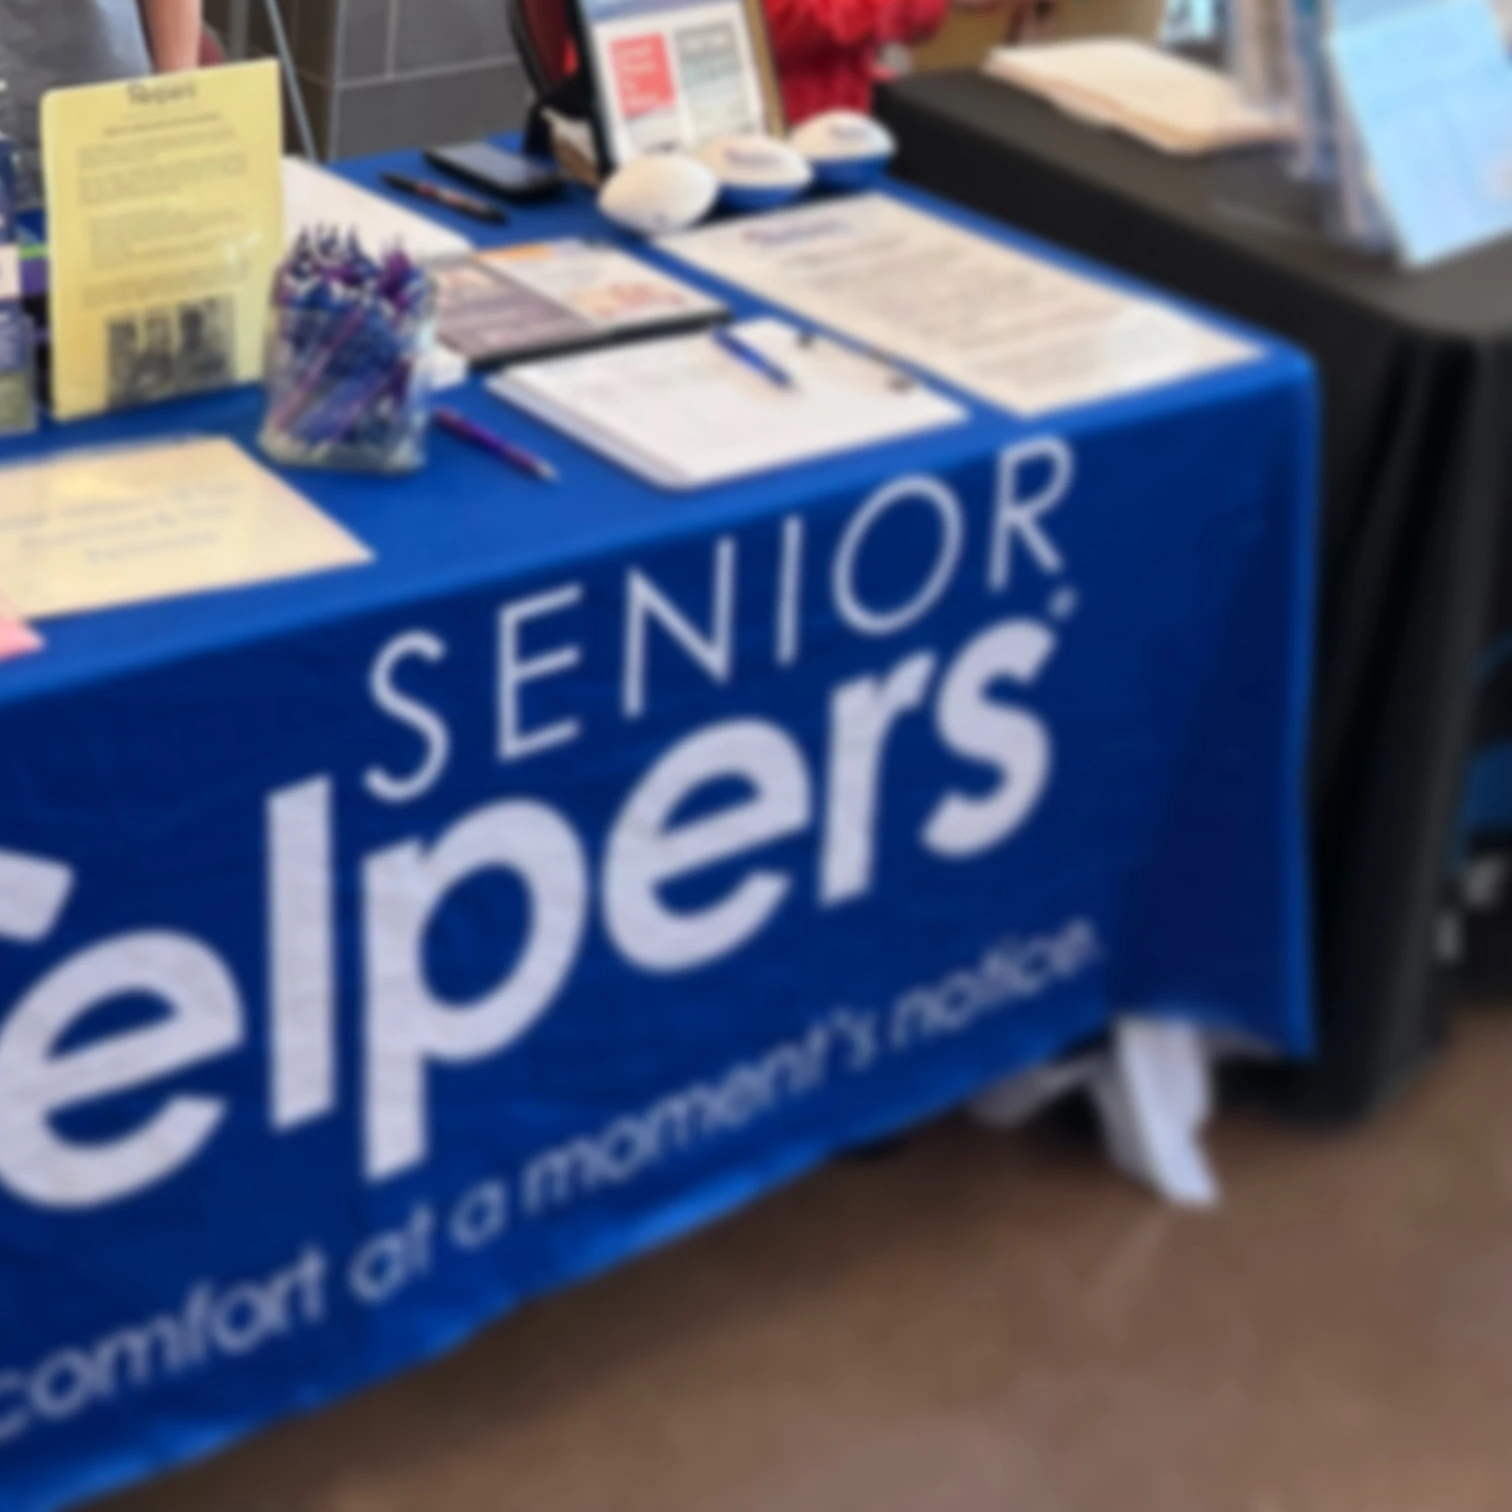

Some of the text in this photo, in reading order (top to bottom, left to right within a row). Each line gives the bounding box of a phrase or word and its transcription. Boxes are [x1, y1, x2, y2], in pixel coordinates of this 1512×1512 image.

[364, 433, 1075, 804] SENIOR
[349, 1203, 434, 1302] at
[449, 1181, 506, 1249] a
[522, 1009, 877, 1212] moment's
